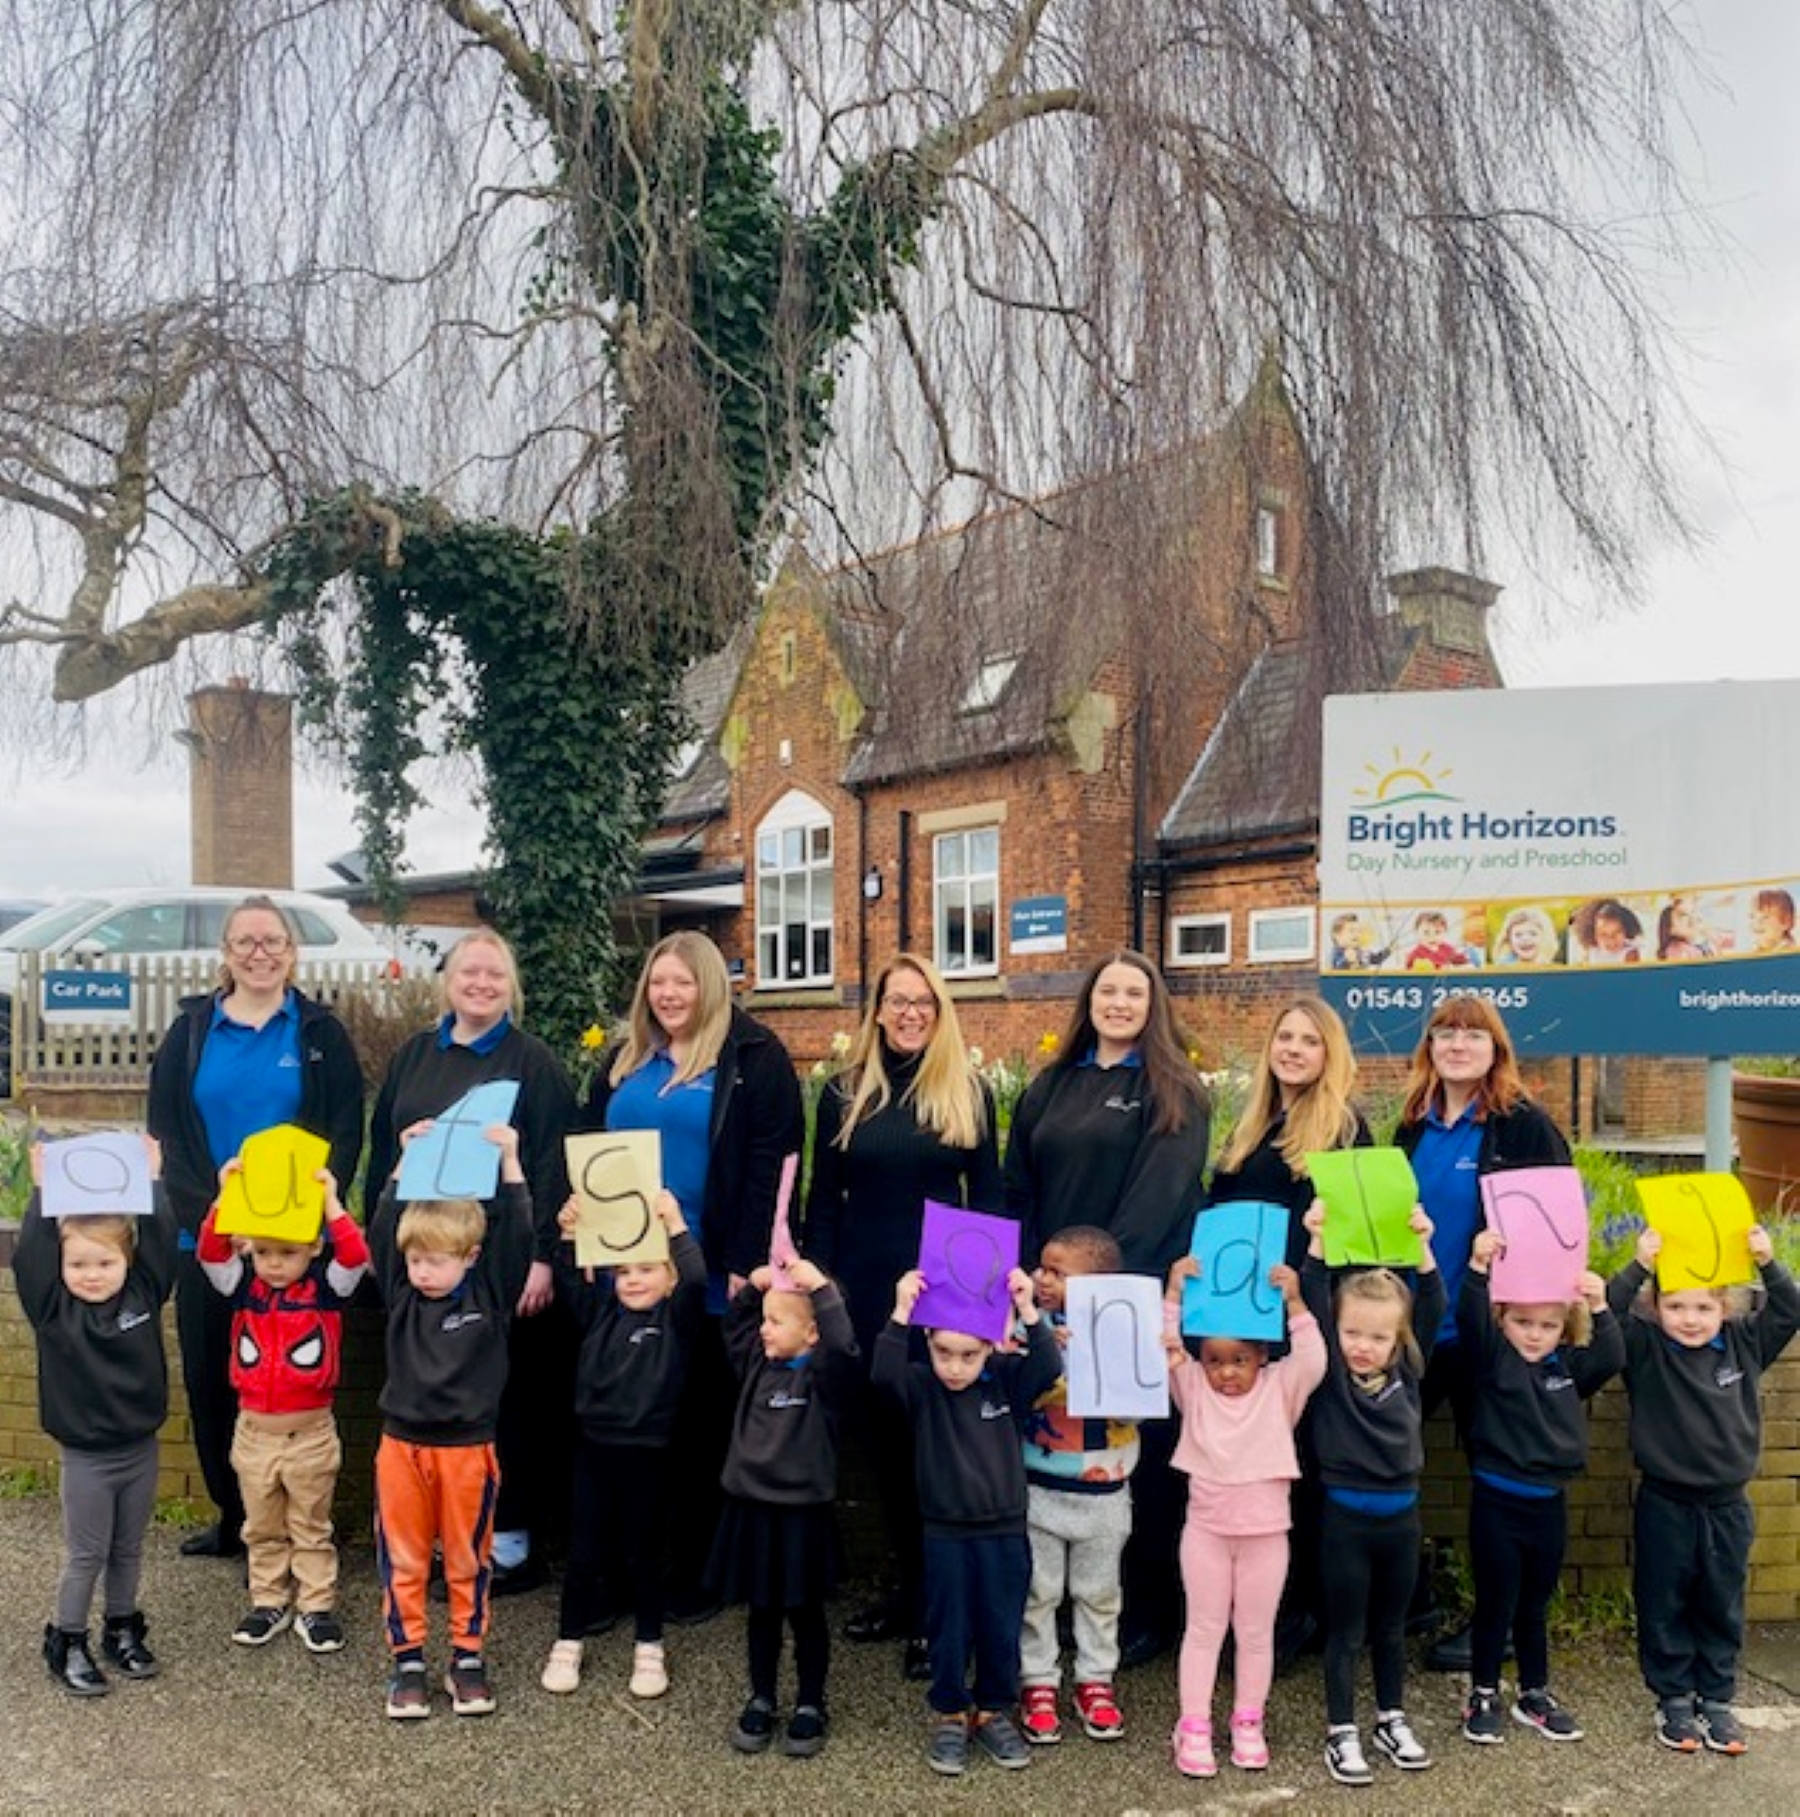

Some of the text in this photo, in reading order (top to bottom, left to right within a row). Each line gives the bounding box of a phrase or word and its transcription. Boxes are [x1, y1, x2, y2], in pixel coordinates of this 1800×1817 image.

[1347, 809, 1617, 848] Bright Horizons
[1347, 847, 1627, 875] Day Nursery and Preschool
[52, 981, 124, 998] Car Park
[1346, 986, 1423, 1009] 01543
[240, 1150, 306, 1219] u
[1211, 1203, 1275, 1315] d
[1090, 1293, 1162, 1407] n
